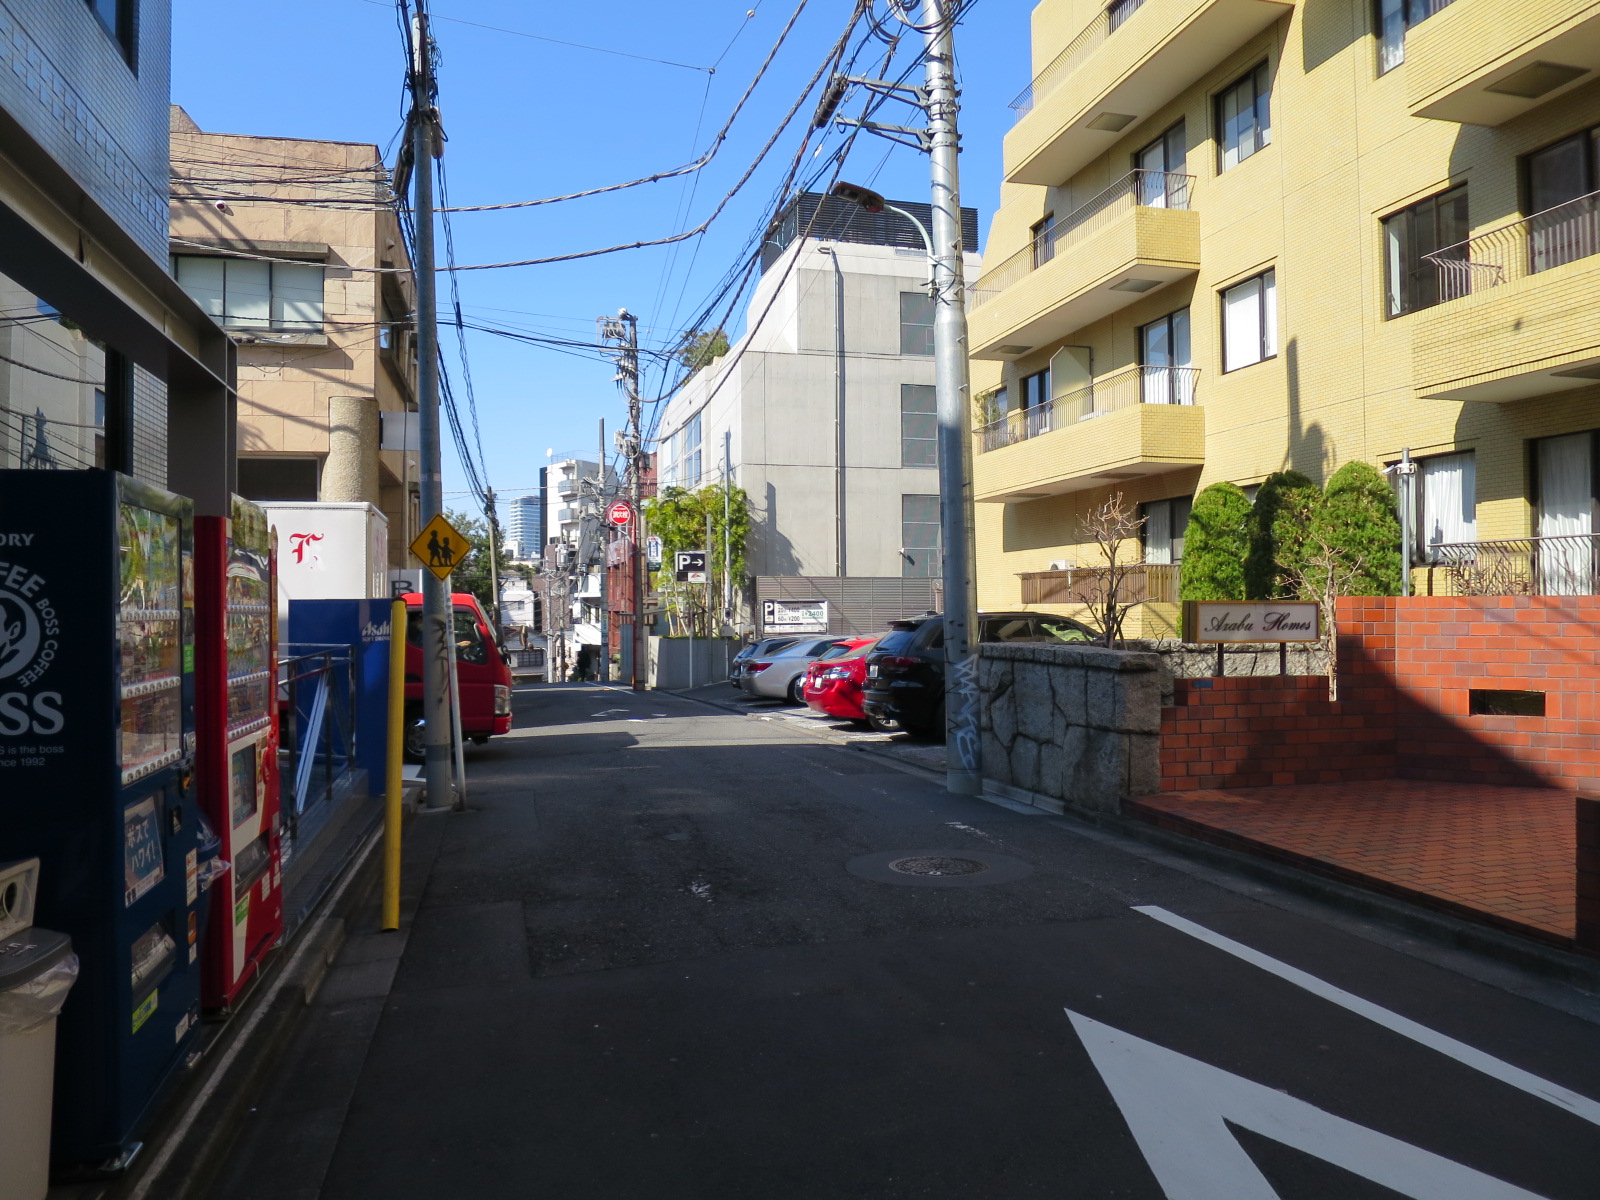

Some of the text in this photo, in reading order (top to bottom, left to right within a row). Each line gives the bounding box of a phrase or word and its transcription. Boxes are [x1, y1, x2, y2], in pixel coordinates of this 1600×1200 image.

[678, 555, 690, 570] P
[764, 602, 774, 616] P
[1204, 612, 1311, 632] Azabu Homes
[17, 598, 60, 688] BOSS COFFEE
[8, 746, 17, 755] is
[20, 745, 36, 754] the
[39, 745, 64, 754] boss
[21, 757, 46, 766] 1992
[127, 819, 148, 848] ボスで
